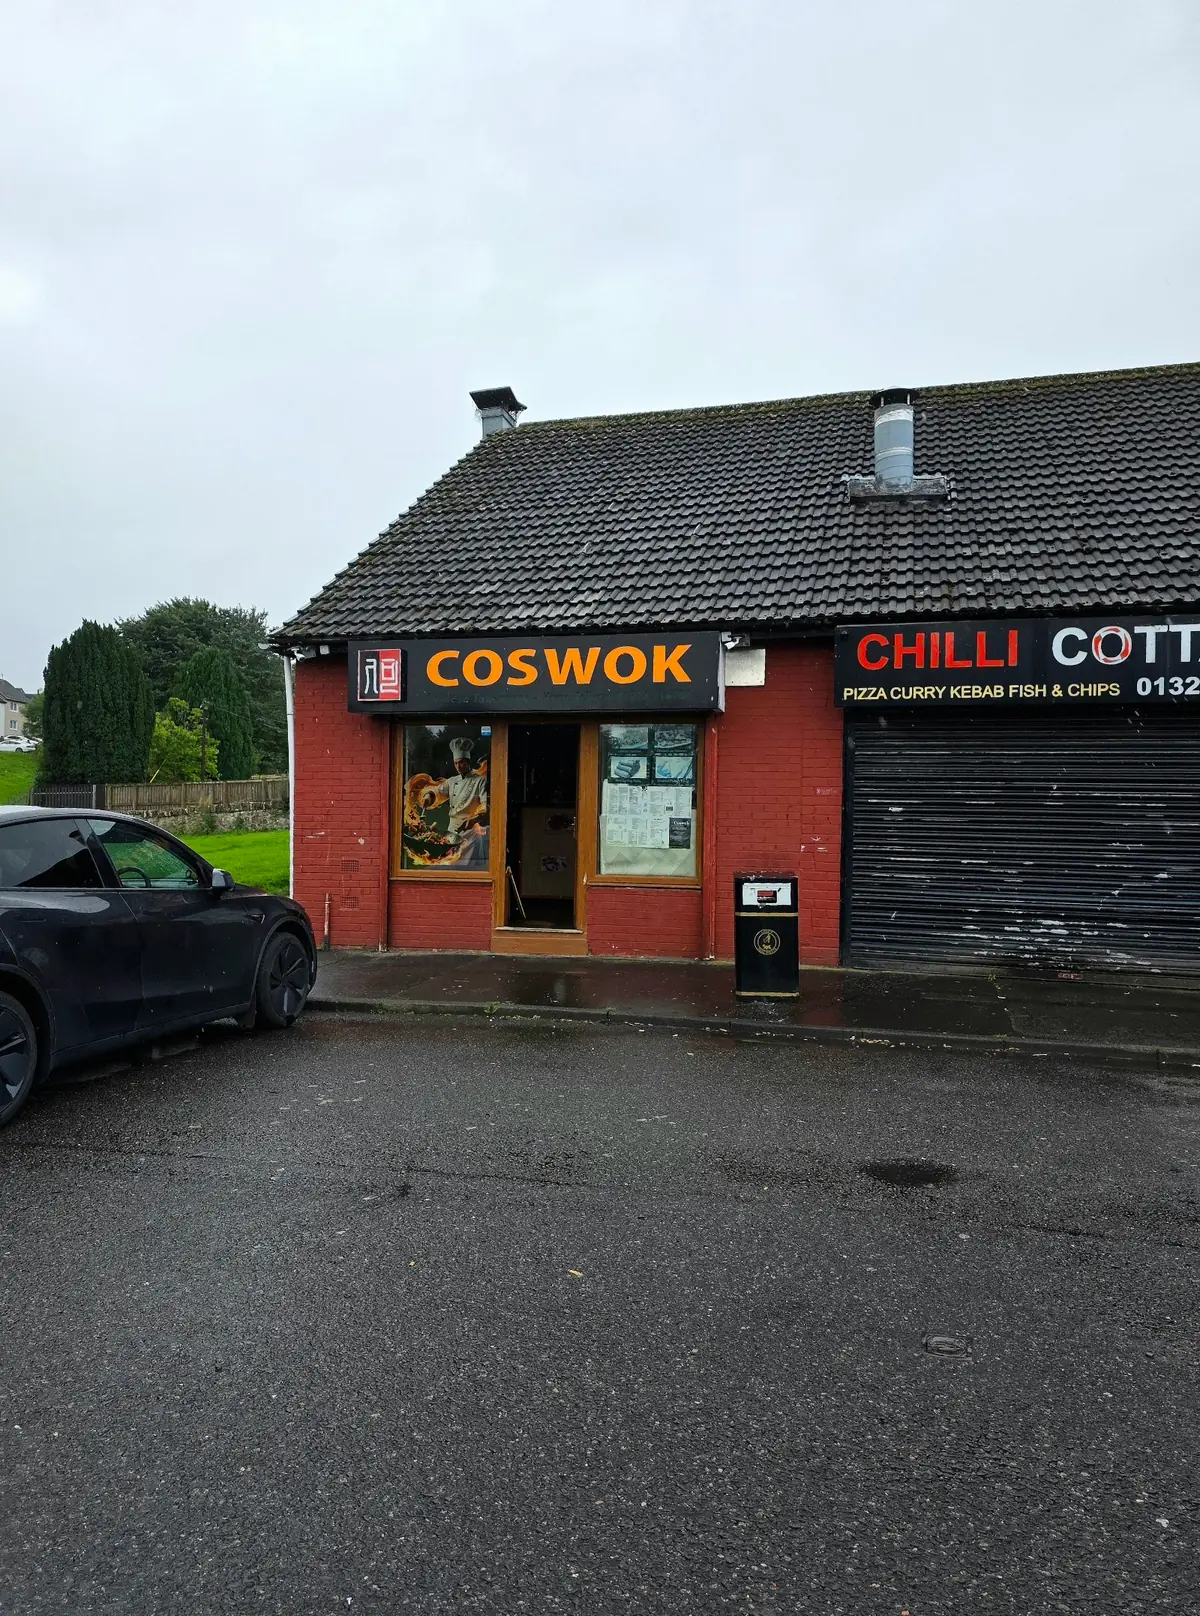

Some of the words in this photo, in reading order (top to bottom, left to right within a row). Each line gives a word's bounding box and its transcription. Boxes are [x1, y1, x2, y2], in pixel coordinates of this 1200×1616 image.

[857, 630, 1018, 671] CHILLI
[1051, 623, 1200, 666] COTT
[426, 644, 692, 687] COSWOK
[843, 687, 888, 701] PIZZA
[889, 686, 947, 700] CURRY
[950, 685, 1005, 699] KEBAB
[1008, 684, 1047, 698] FISH
[1051, 683, 1064, 698] &
[1067, 683, 1121, 697] CHIPS
[1136, 677, 1200, 696] 0132
